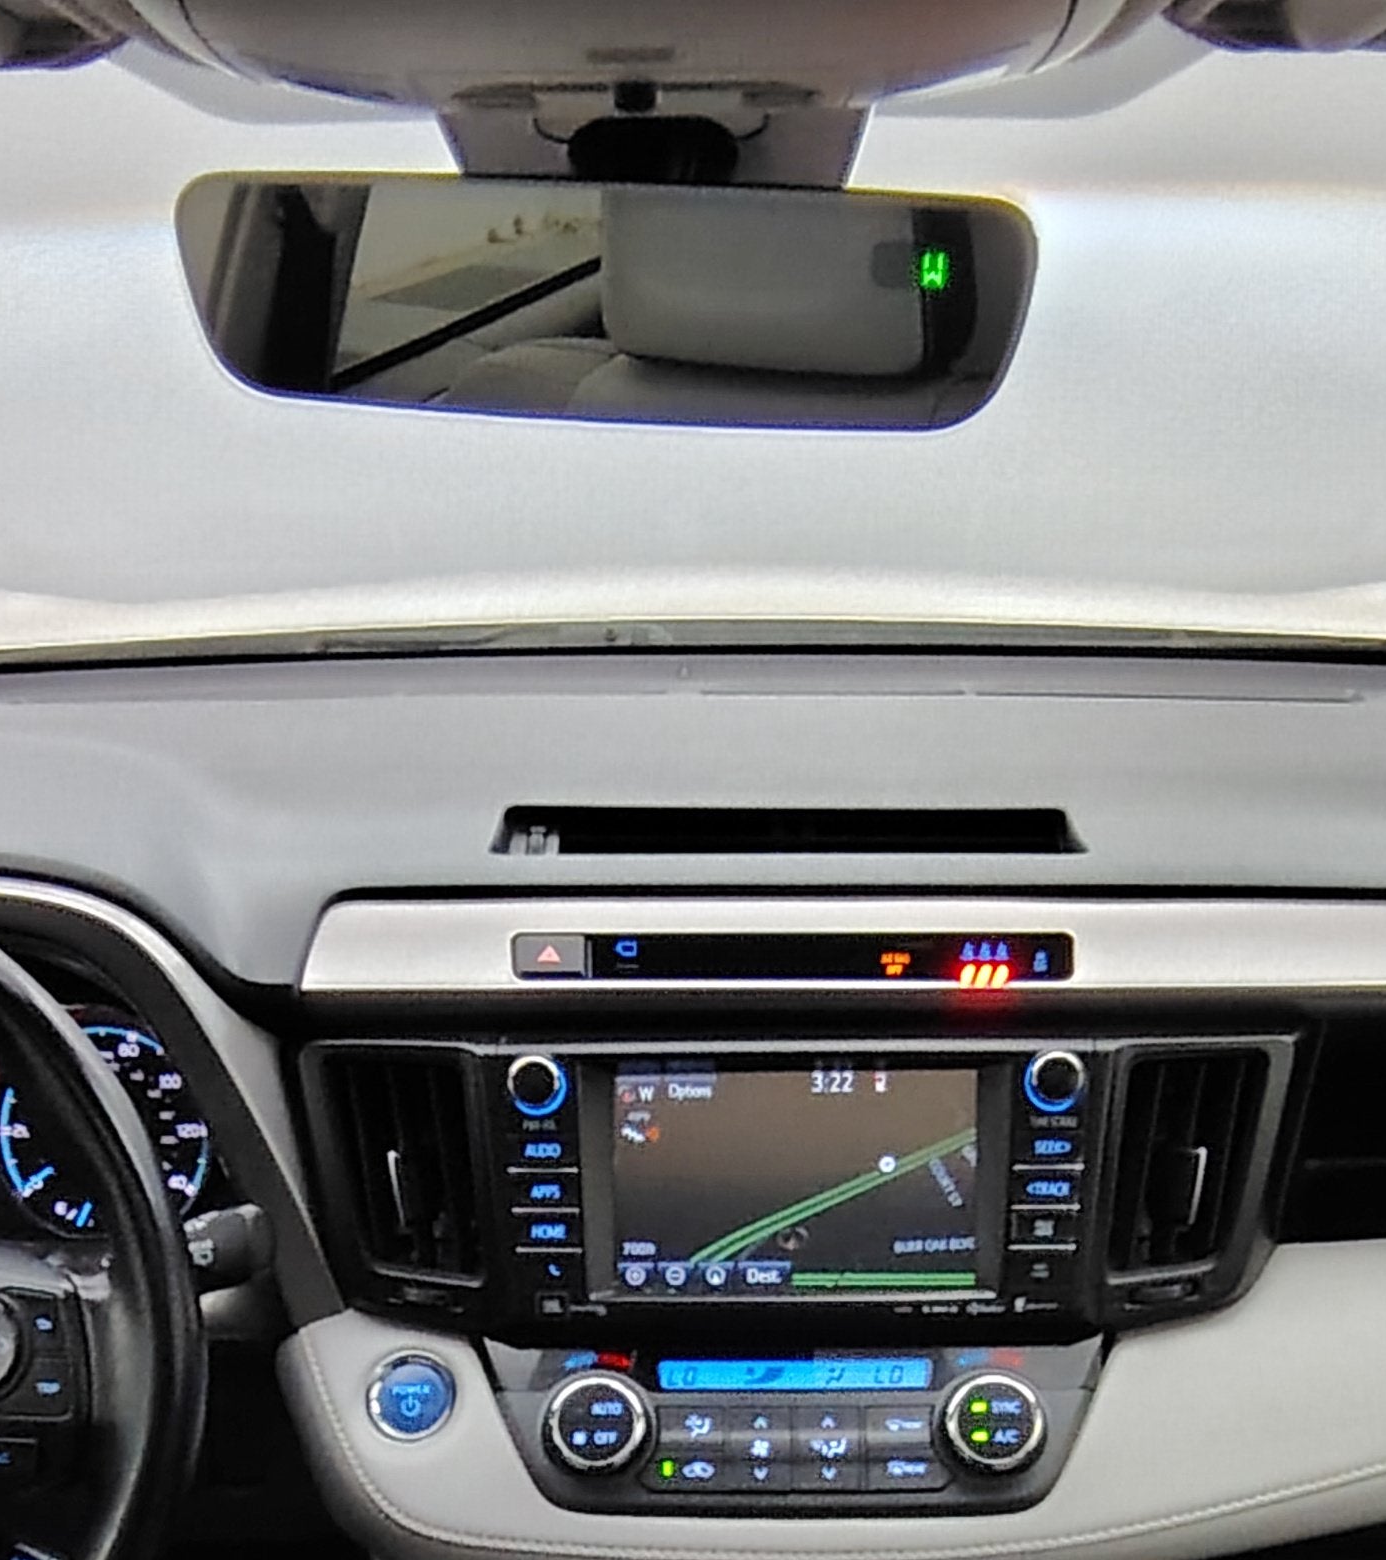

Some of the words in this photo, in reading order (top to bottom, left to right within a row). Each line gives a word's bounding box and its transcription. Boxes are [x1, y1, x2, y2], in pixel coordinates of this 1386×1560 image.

[922, 252, 945, 287] W
[811, 1071, 854, 1093] 3:22
[638, 1085, 655, 1102] W
[667, 1083, 713, 1101] Options
[745, 1268, 783, 1284] Dest.
[873, 1367, 904, 1385] LO
[382, 1383, 430, 1395] POWER
[590, 1400, 624, 1416] AUTO
[593, 1430, 618, 1446] OFF
